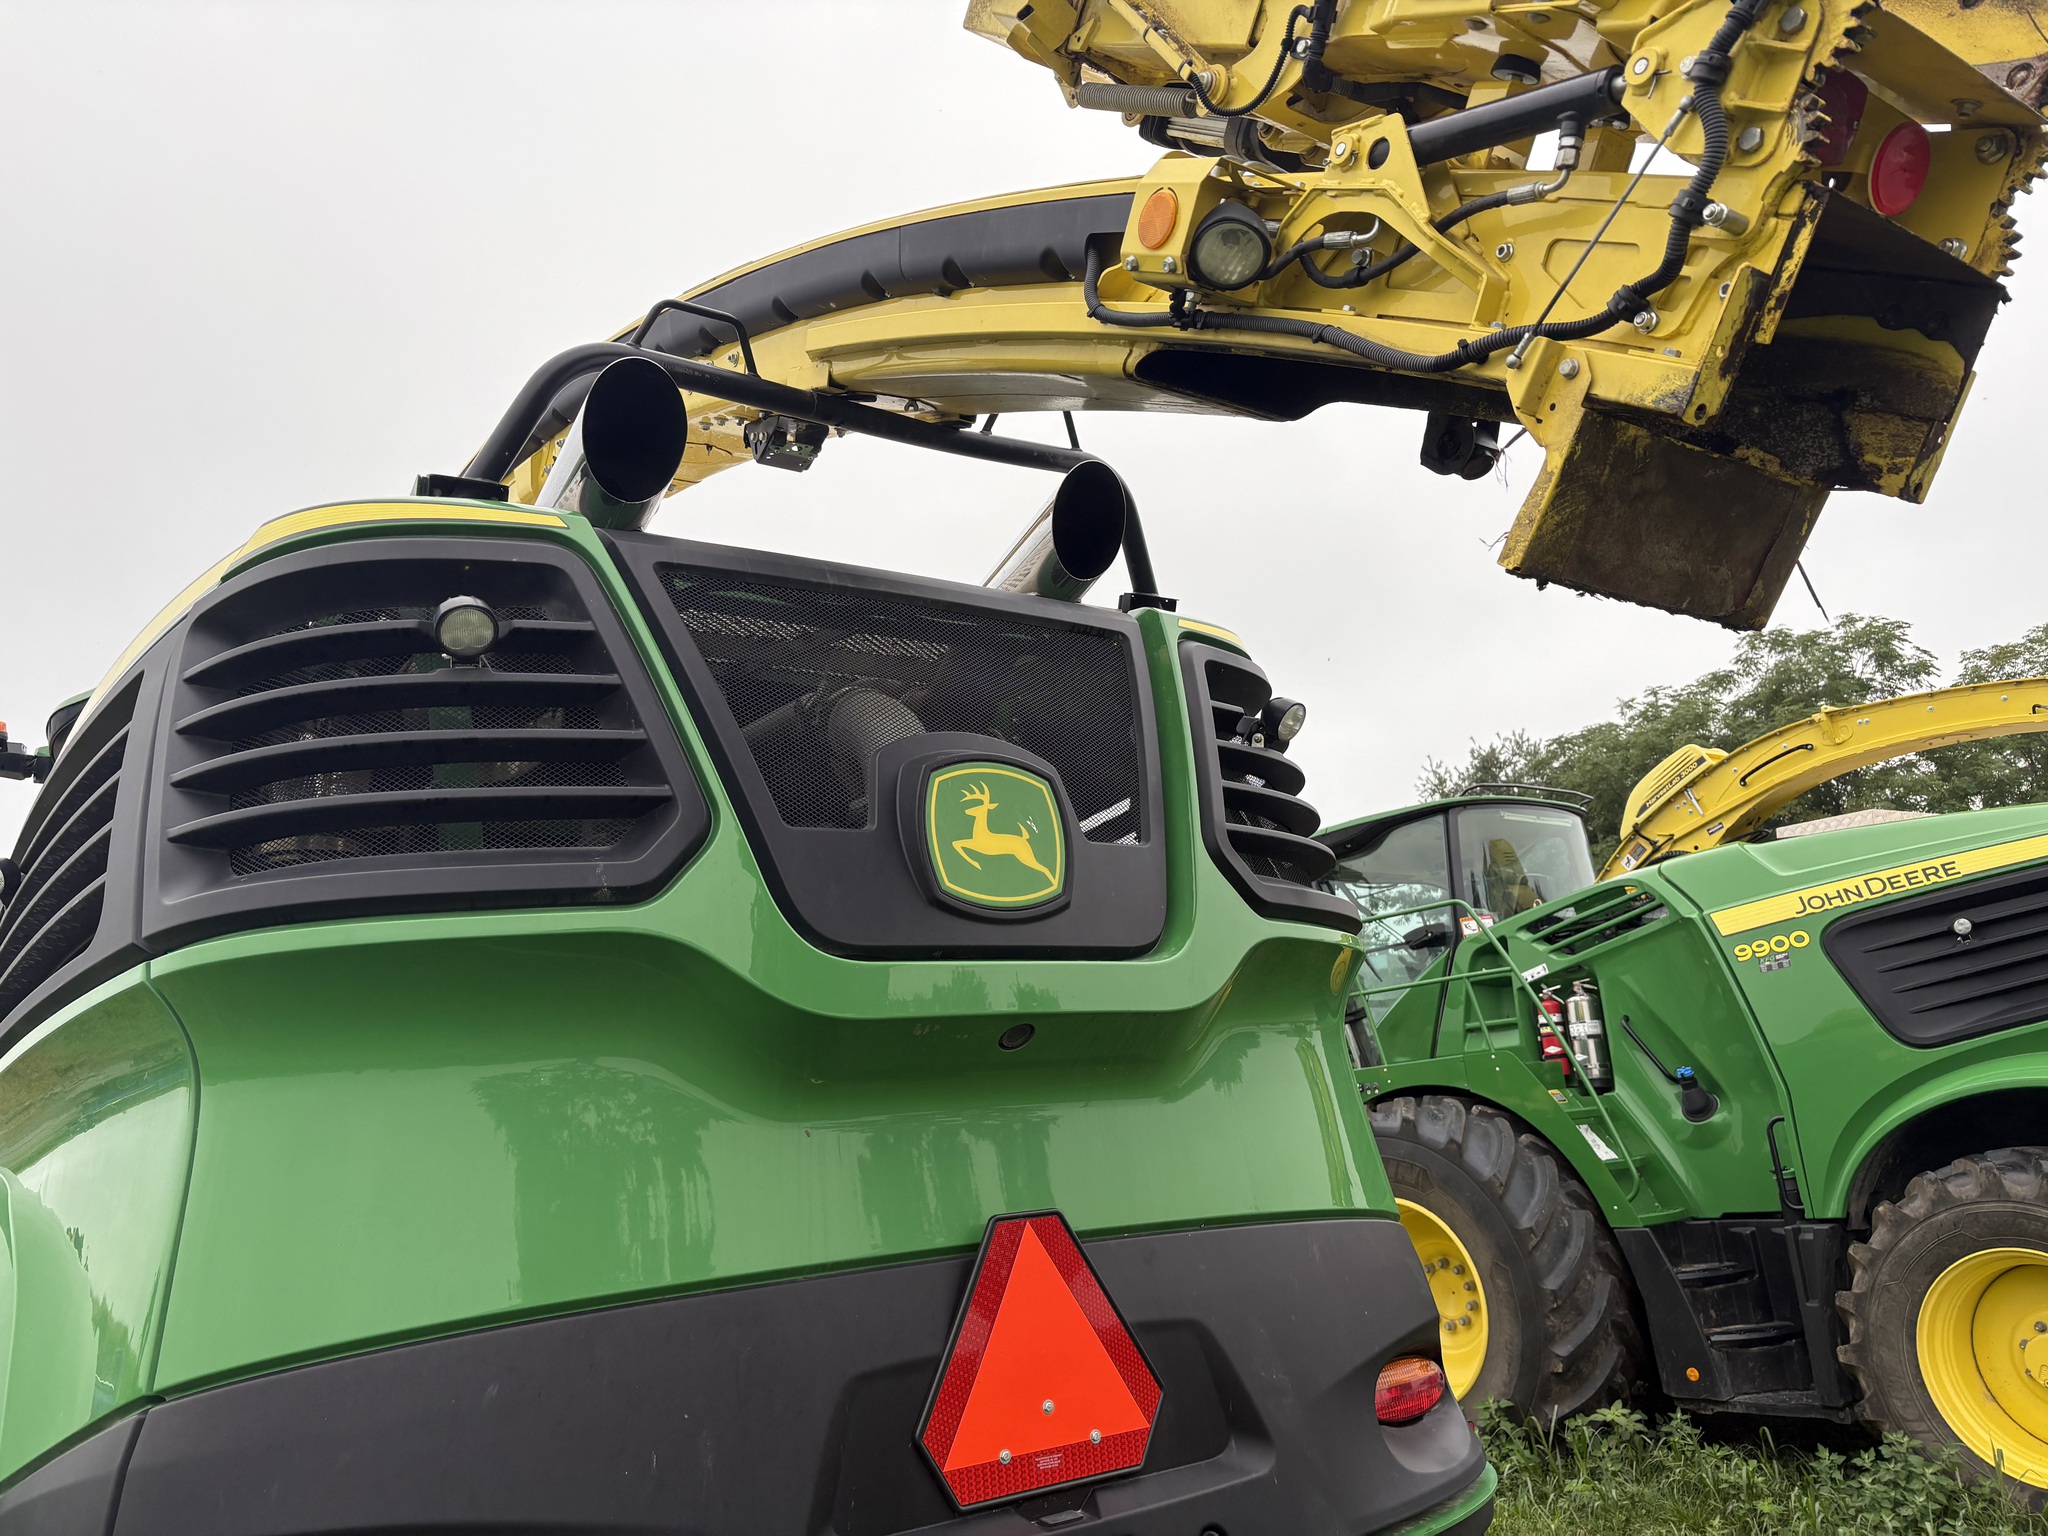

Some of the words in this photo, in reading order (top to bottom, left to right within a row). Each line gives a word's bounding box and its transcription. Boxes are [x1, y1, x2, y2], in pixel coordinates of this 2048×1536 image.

[1646, 775, 1681, 807] HarvestLab
[1680, 762, 1698, 778] 3000
[1795, 884, 1864, 915] JOHN
[1863, 860, 1962, 896] DEERE
[1733, 930, 1810, 962] 9900
